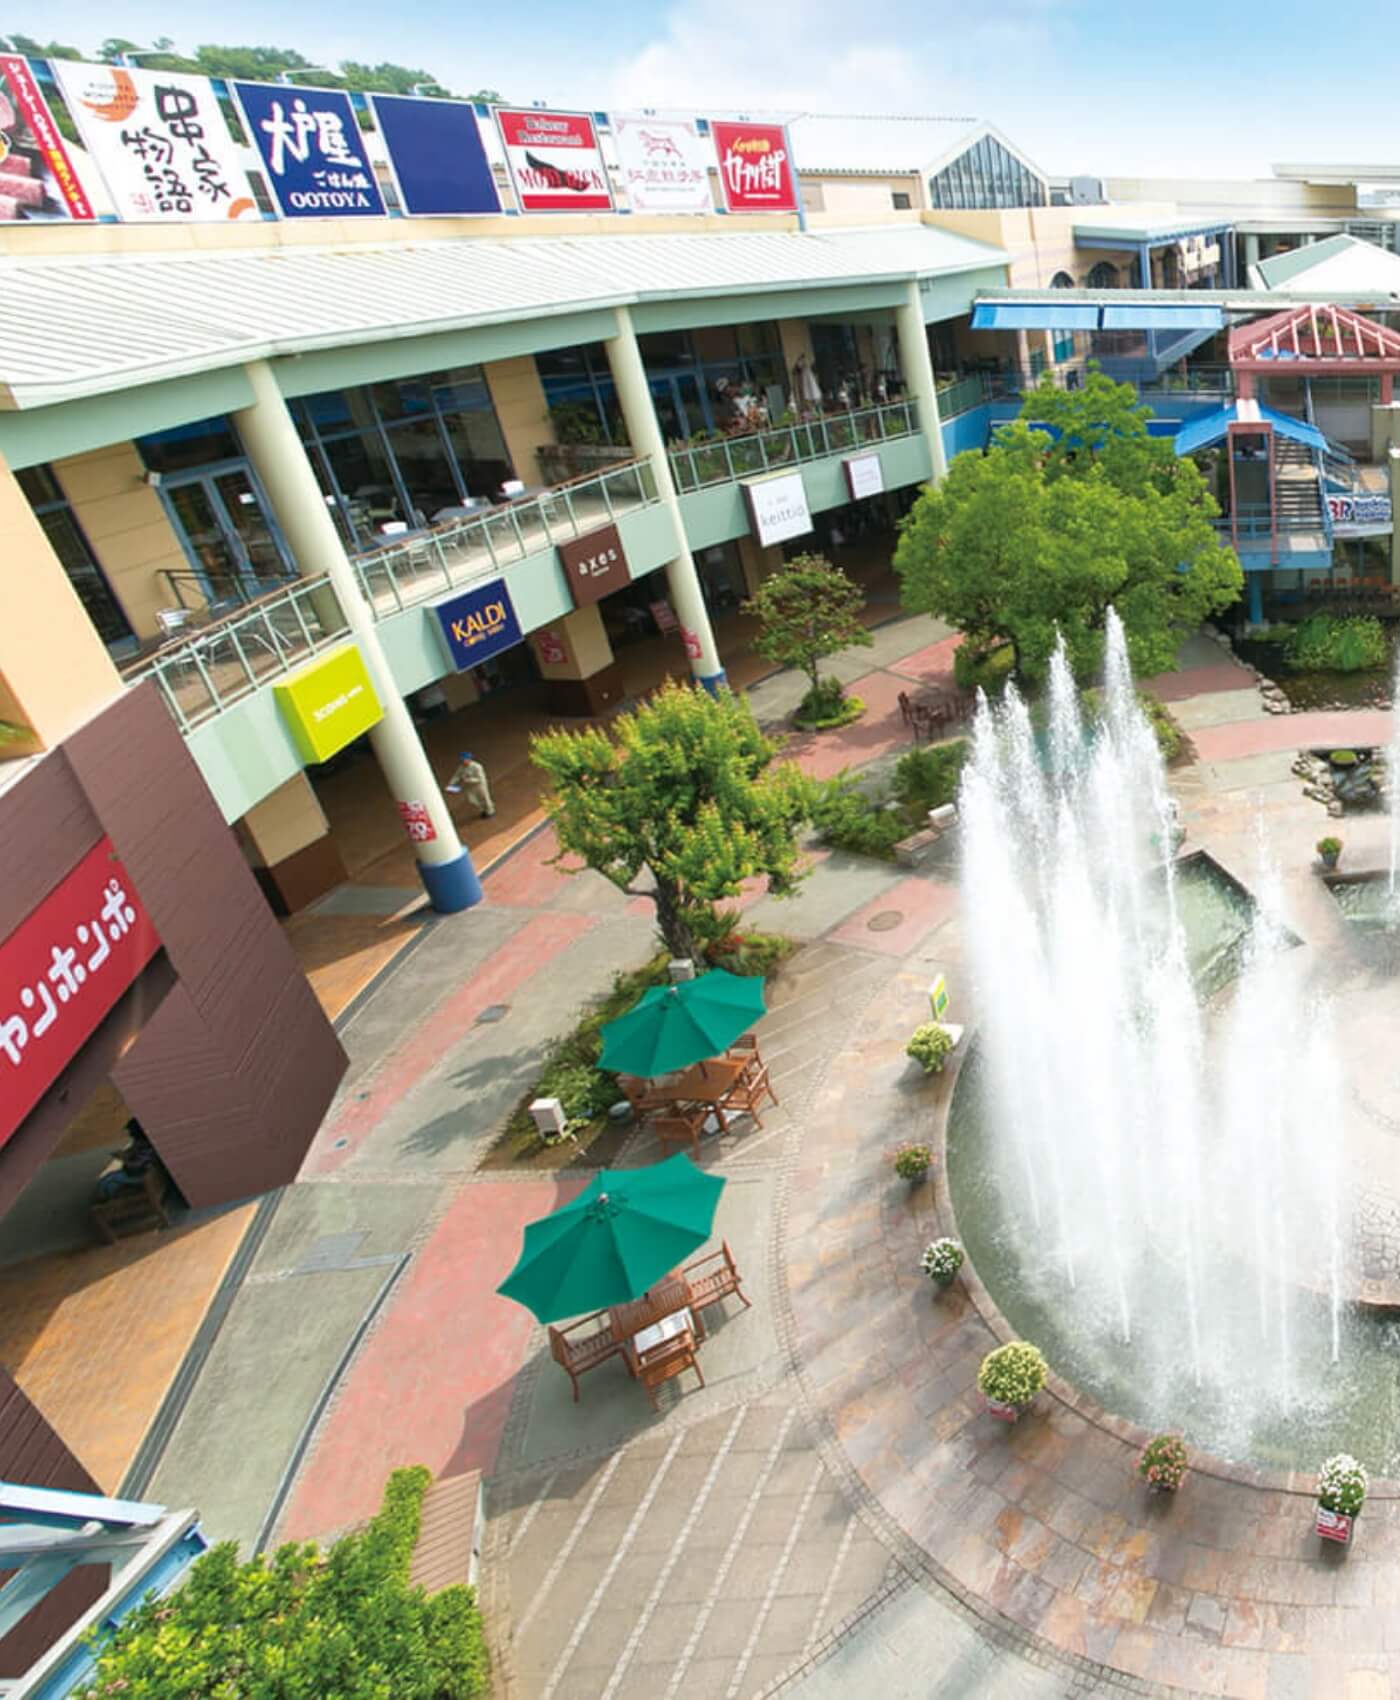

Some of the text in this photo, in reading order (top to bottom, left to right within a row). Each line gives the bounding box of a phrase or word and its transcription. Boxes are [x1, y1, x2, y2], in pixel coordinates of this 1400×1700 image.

[121, 126, 194, 214] 物語
[154, 84, 232, 203] 串家
[261, 98, 363, 175] 大戸屋
[290, 191, 371, 208] OOTOYA
[451, 600, 507, 642] KALDI
